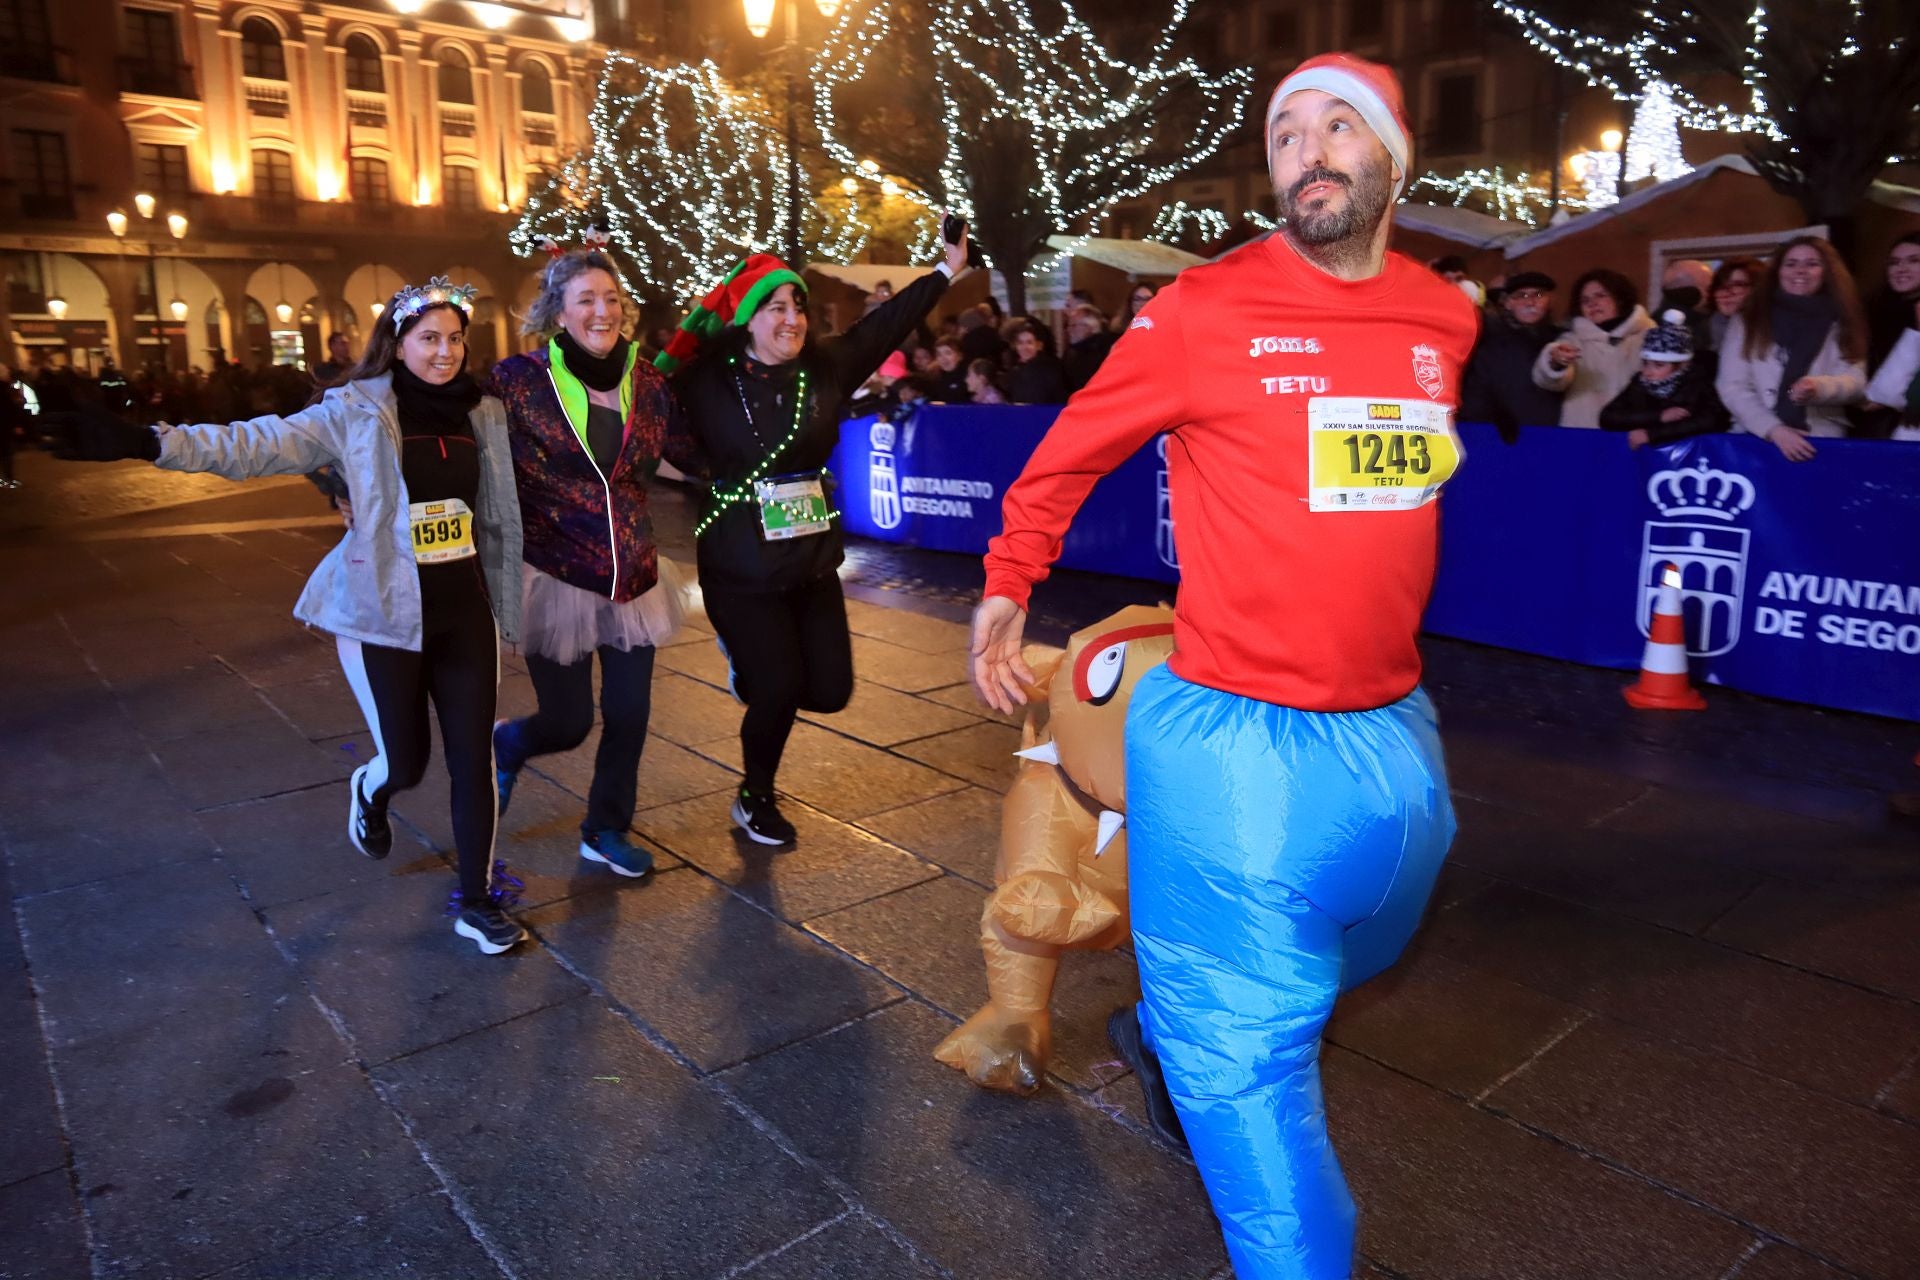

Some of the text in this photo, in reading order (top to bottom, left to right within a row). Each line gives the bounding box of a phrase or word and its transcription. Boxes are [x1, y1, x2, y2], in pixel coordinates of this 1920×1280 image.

[1261, 376, 1329, 394] TETU
[1368, 404, 1401, 420] GADIS
[1322, 422, 1346, 430] XXXIV
[1343, 433, 1431, 475] 1243
[1373, 477, 1404, 486] TETU
[411, 517, 463, 546] 1593
[1754, 606, 1920, 655] DE SEGO
